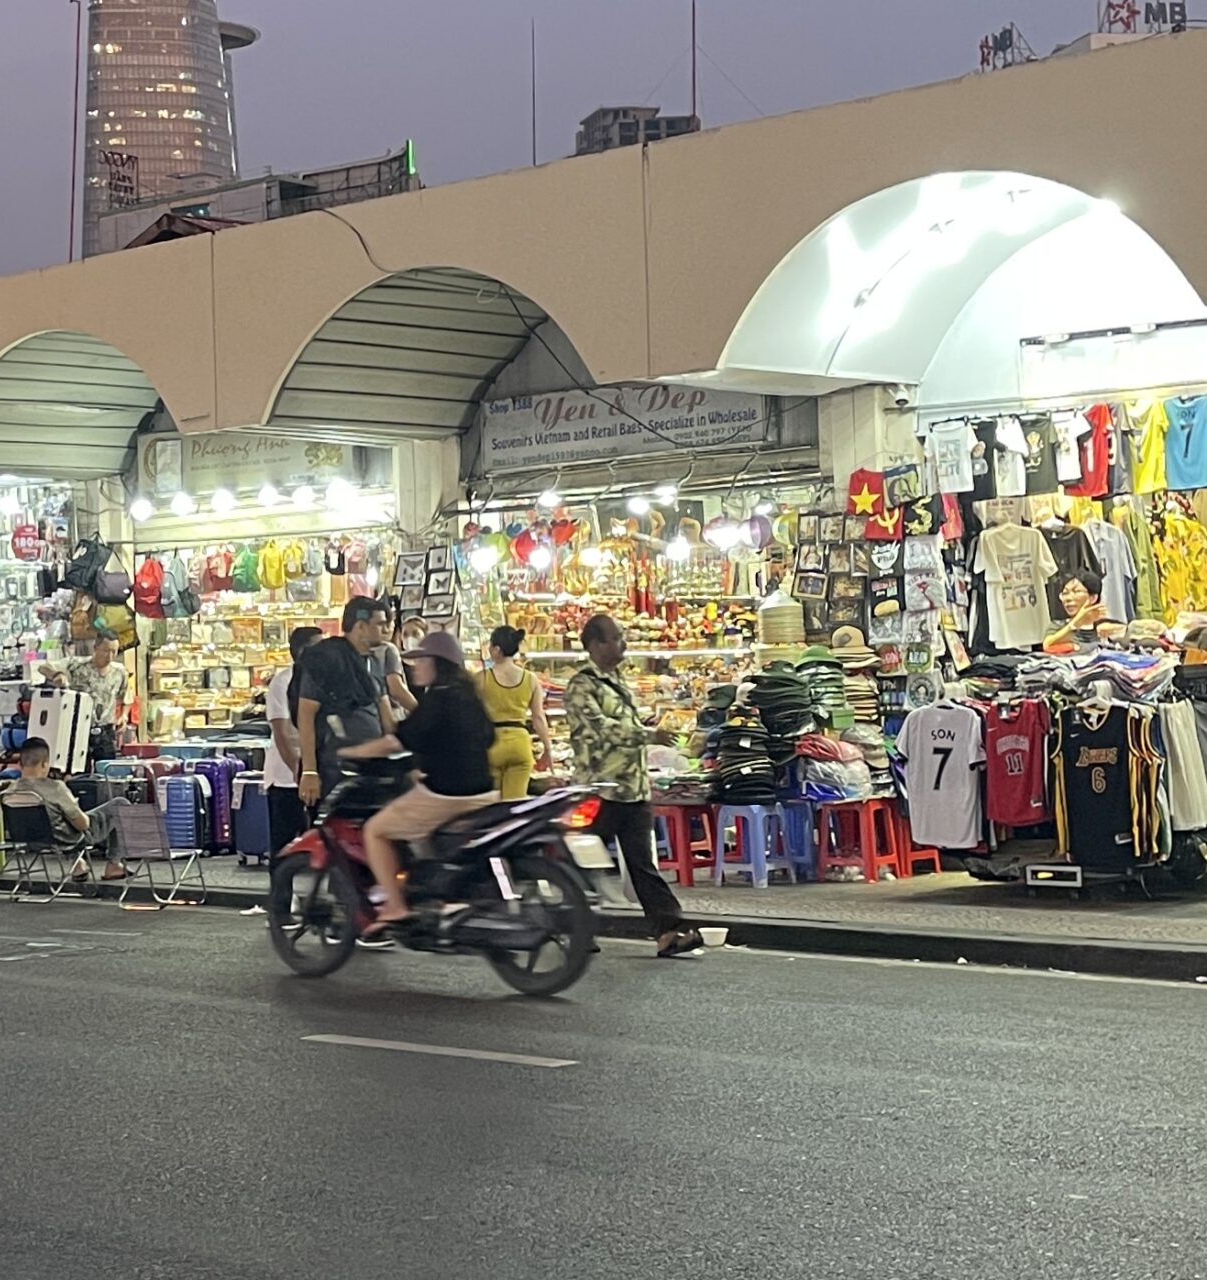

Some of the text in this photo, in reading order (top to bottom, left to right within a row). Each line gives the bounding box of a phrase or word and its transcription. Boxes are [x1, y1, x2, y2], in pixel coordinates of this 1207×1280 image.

[1144, 2, 1187, 24] MB
[535, 431, 571, 445] Vietnam
[573, 429, 589, 441] and
[648, 415, 695, 432] Specialize
[697, 415, 707, 427] in
[708, 408, 758, 426] Wholesale
[1180, 423, 1194, 458] 7
[931, 728, 955, 742] SON
[932, 747, 953, 791] 7
[1006, 752, 1024, 776] 11
[1091, 766, 1106, 794] 6
